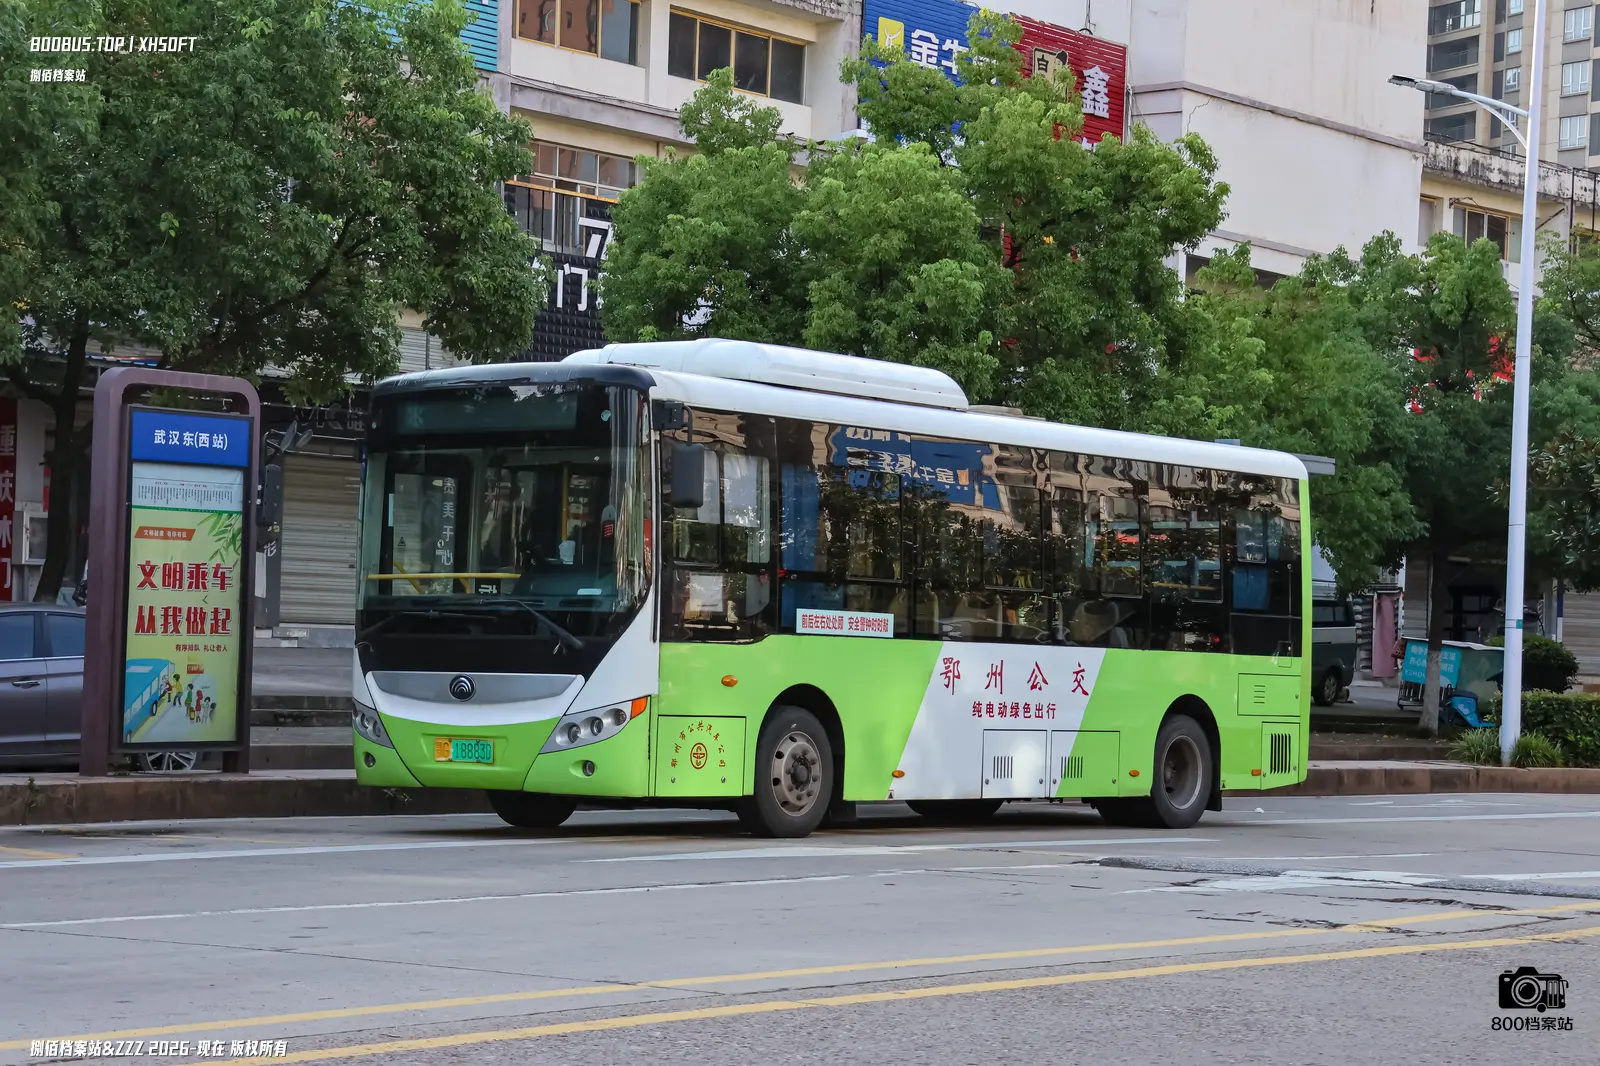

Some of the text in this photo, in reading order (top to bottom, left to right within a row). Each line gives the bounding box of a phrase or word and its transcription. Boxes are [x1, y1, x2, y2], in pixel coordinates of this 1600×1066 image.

[1081, 64, 1111, 119] 鑫
[154, 429, 228, 451] 武汉东(西站)
[137, 560, 233, 592] 文明乘车
[135, 605, 232, 636] 从我做起
[801, 613, 844, 630] 前后左右处处顾
[939, 656, 1090, 697] 鄂州公交
[972, 701, 1057, 720] 纯电动绿色出行
